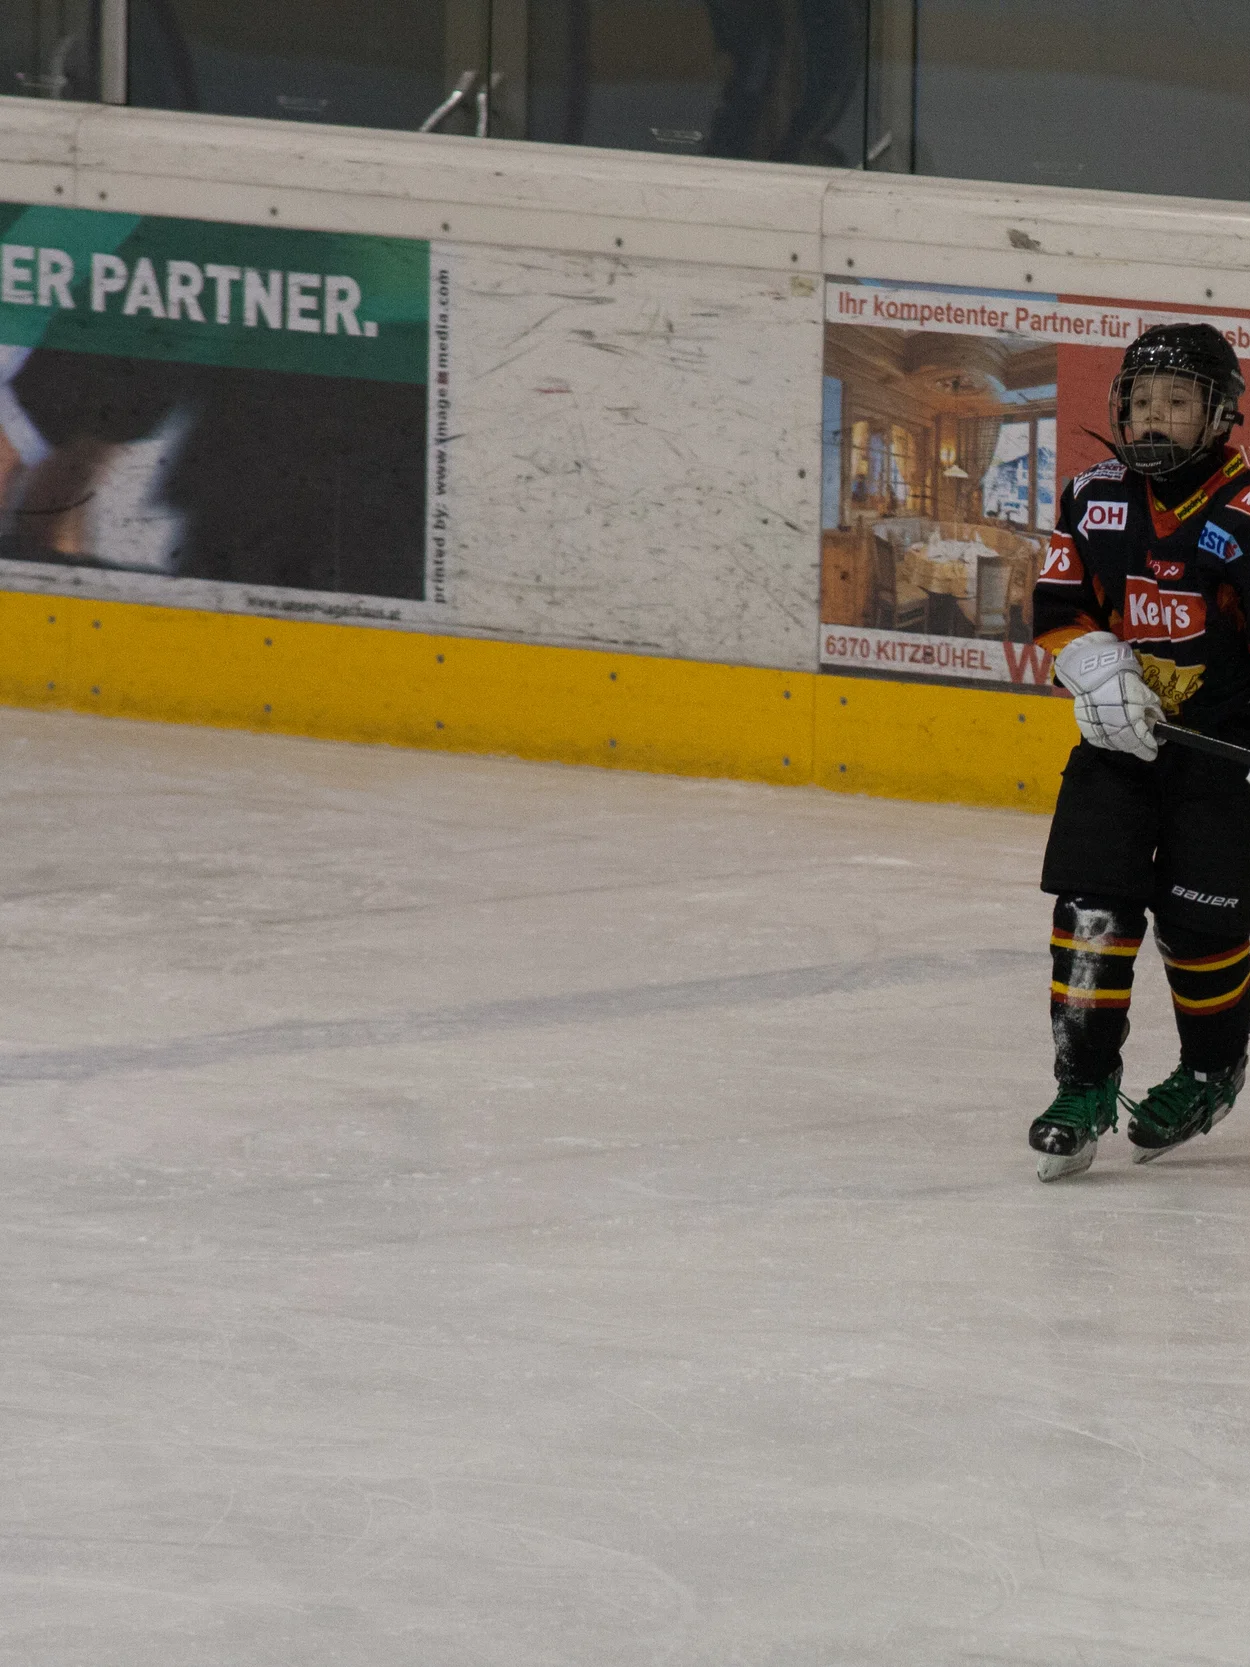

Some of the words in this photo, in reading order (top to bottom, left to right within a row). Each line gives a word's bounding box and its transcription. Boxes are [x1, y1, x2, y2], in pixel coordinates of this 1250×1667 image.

[91, 251, 379, 338] PARTNER.
[838, 291, 865, 316] Ihr
[873, 295, 1009, 328] kompetenter
[1014, 307, 1094, 335] Partner
[1099, 315, 1130, 339] für
[1088, 505, 1123, 525] OH
[433, 535, 447, 604] printed
[1129, 593, 1191, 635] Ke's
[825, 635, 870, 658] 6370
[876, 639, 993, 671] KITZBÜHEL
[1171, 885, 1239, 908] BAUER
